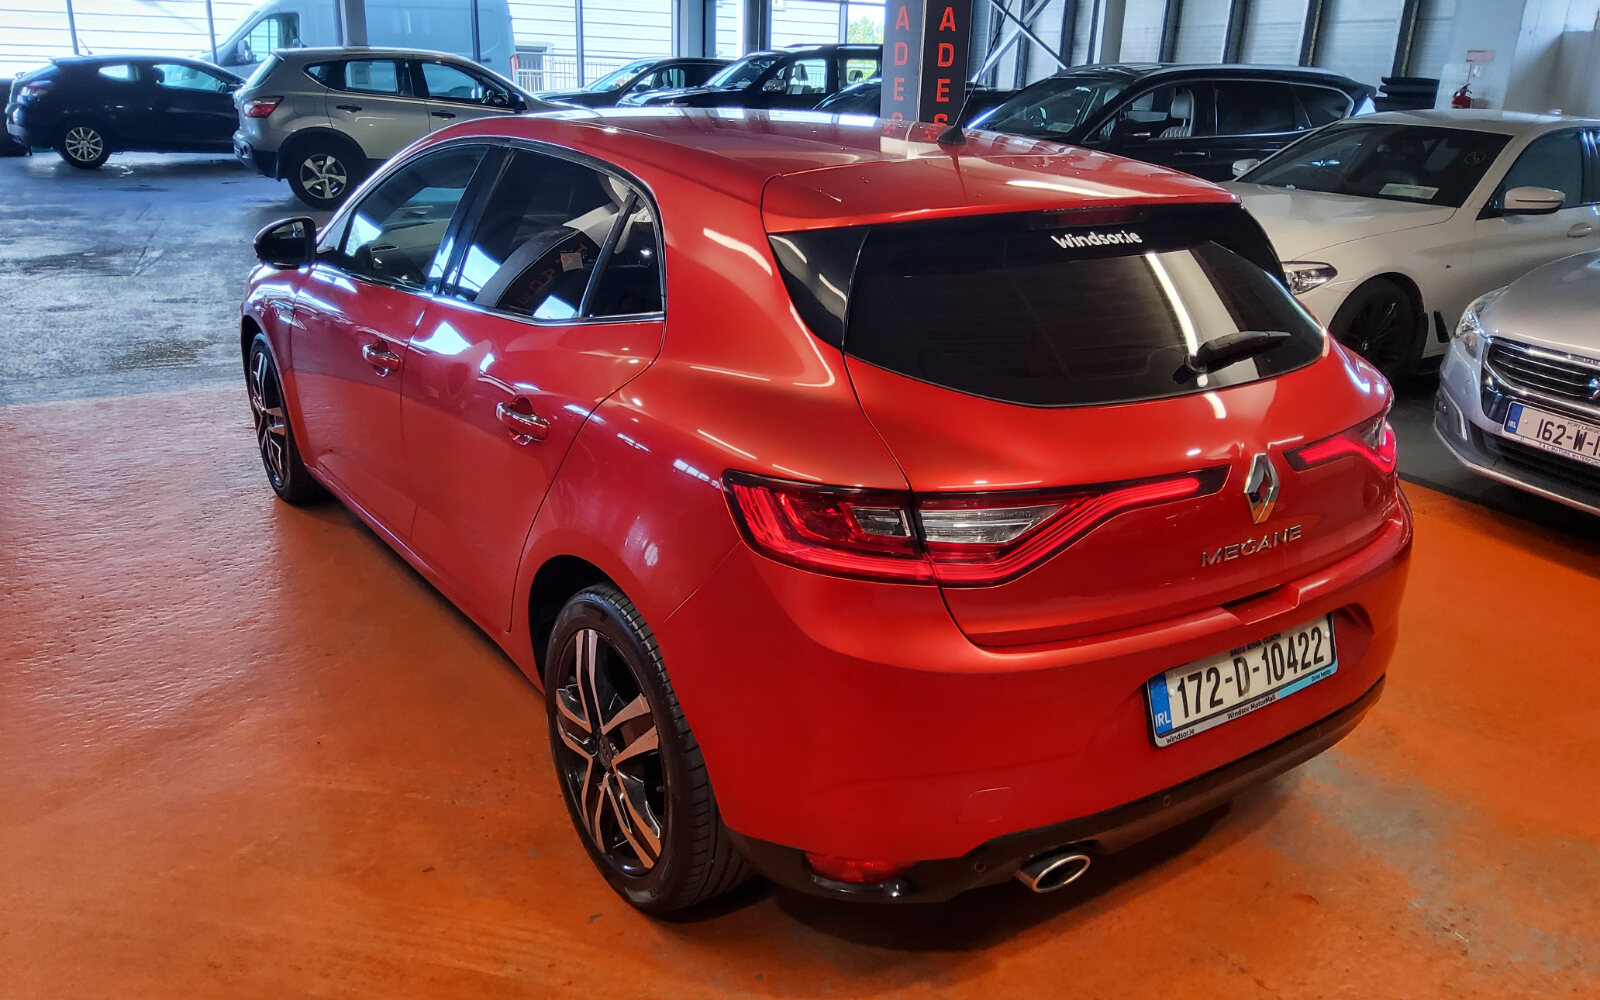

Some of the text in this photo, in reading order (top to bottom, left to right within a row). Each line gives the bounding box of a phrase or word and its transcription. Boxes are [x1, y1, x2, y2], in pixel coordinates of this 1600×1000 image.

[1050, 230, 1143, 249] Windsor.ie
[1536, 418, 1600, 457] 162-W-1
[1201, 524, 1302, 568] MEGANE
[1177, 626, 1325, 719] 172-D-10422
[1154, 710, 1171, 728] IRL
[1227, 694, 1277, 720] Windsor MotorMall
